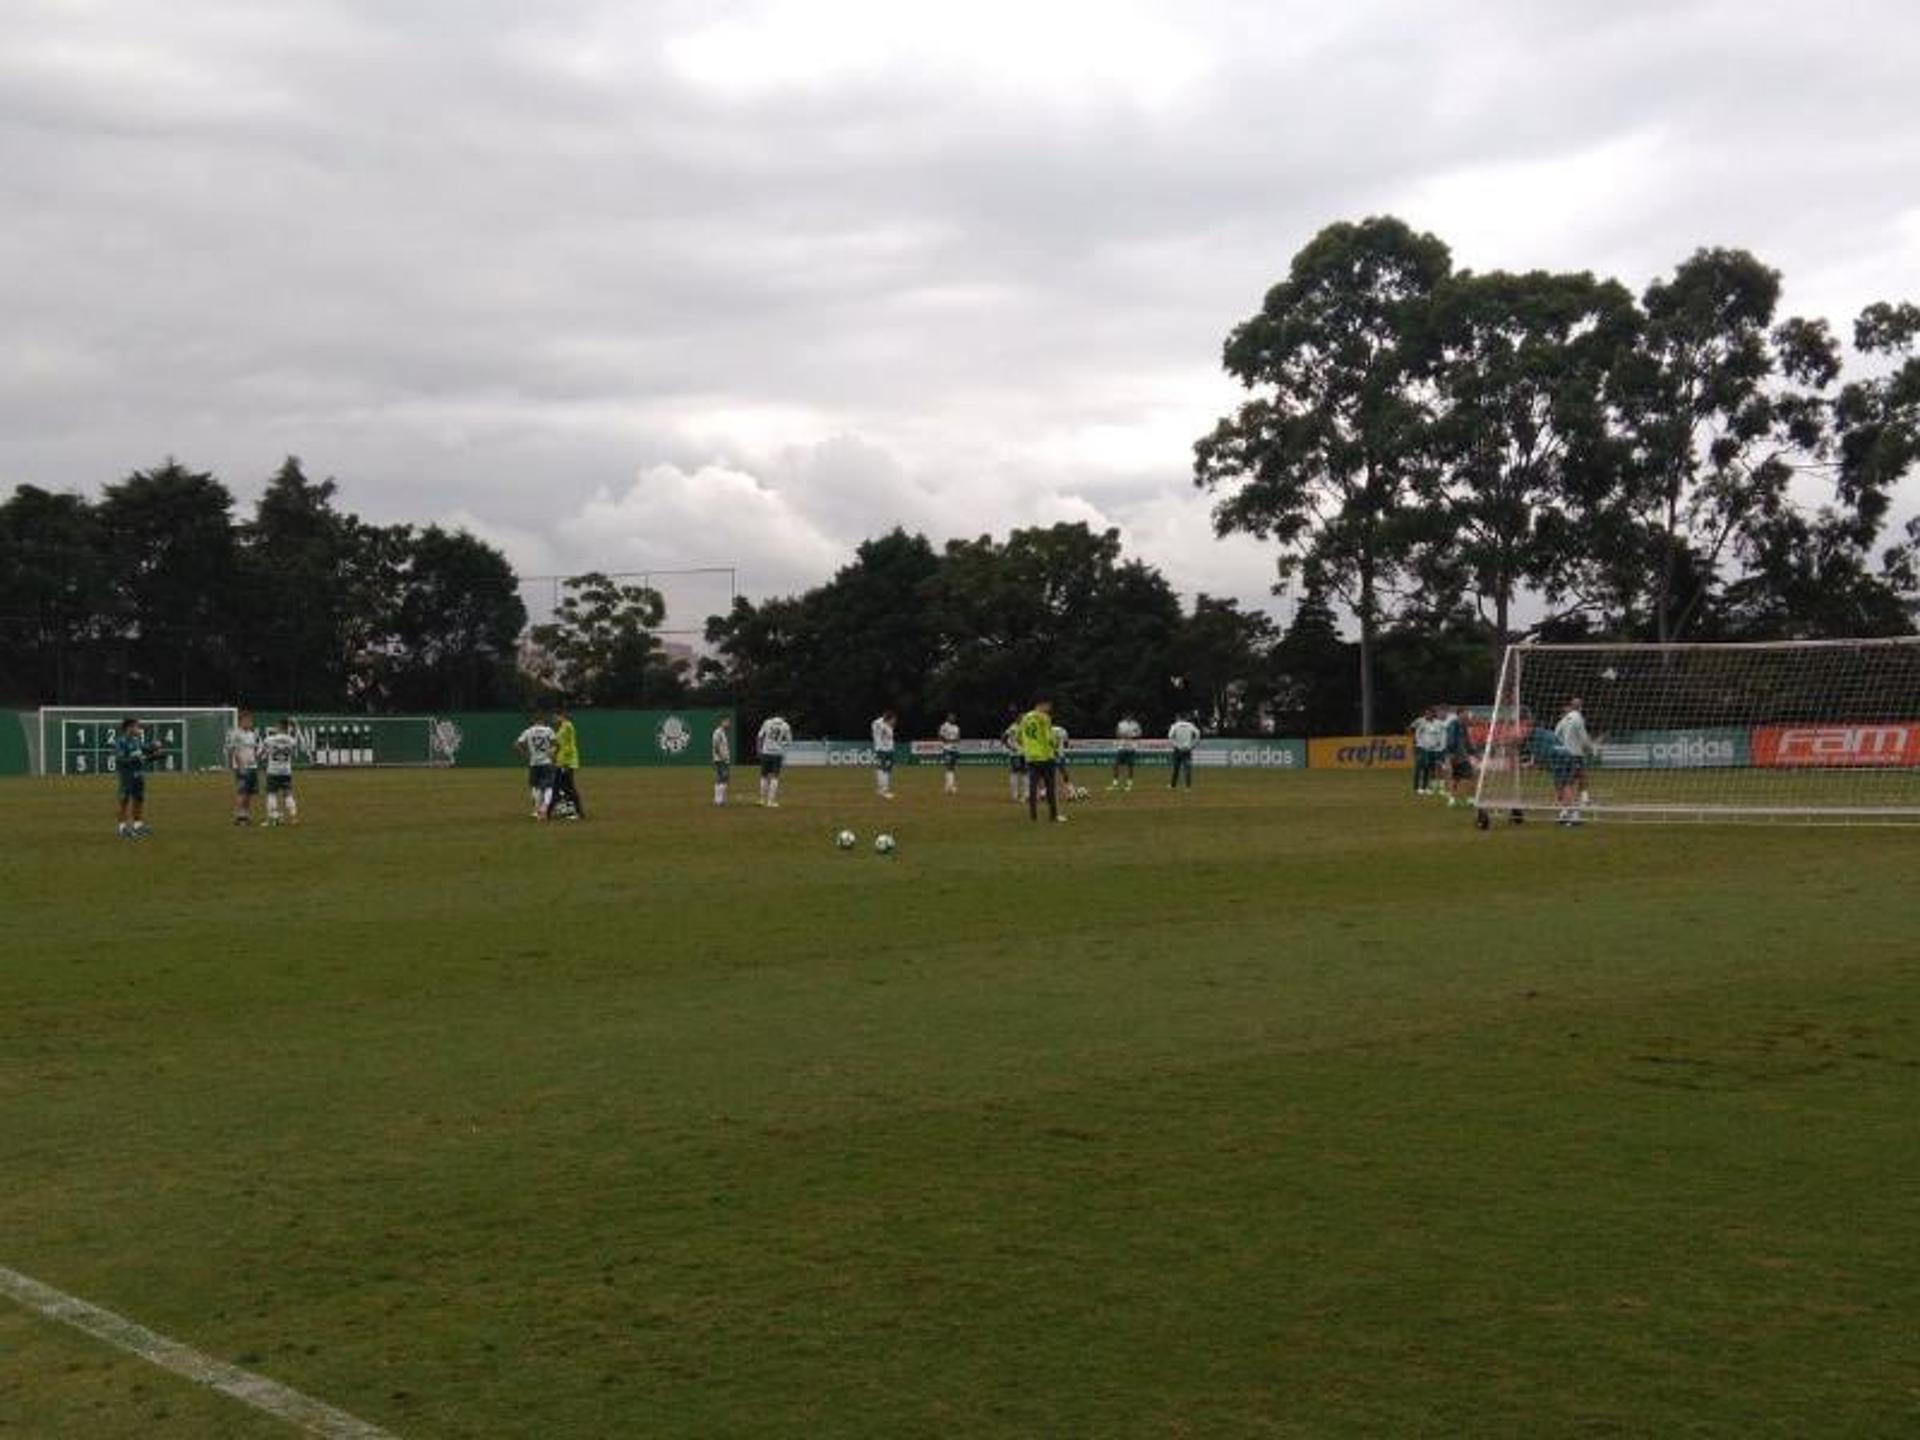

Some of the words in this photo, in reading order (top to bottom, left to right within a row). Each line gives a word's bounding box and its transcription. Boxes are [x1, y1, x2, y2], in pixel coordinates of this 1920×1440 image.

[77, 728, 85, 744] 1
[107, 728, 116, 744] 2
[829, 747, 880, 765] adid
[1230, 745, 1293, 765] adidas
[1336, 740, 1407, 767] crefisa
[1652, 735, 1735, 759] adidas
